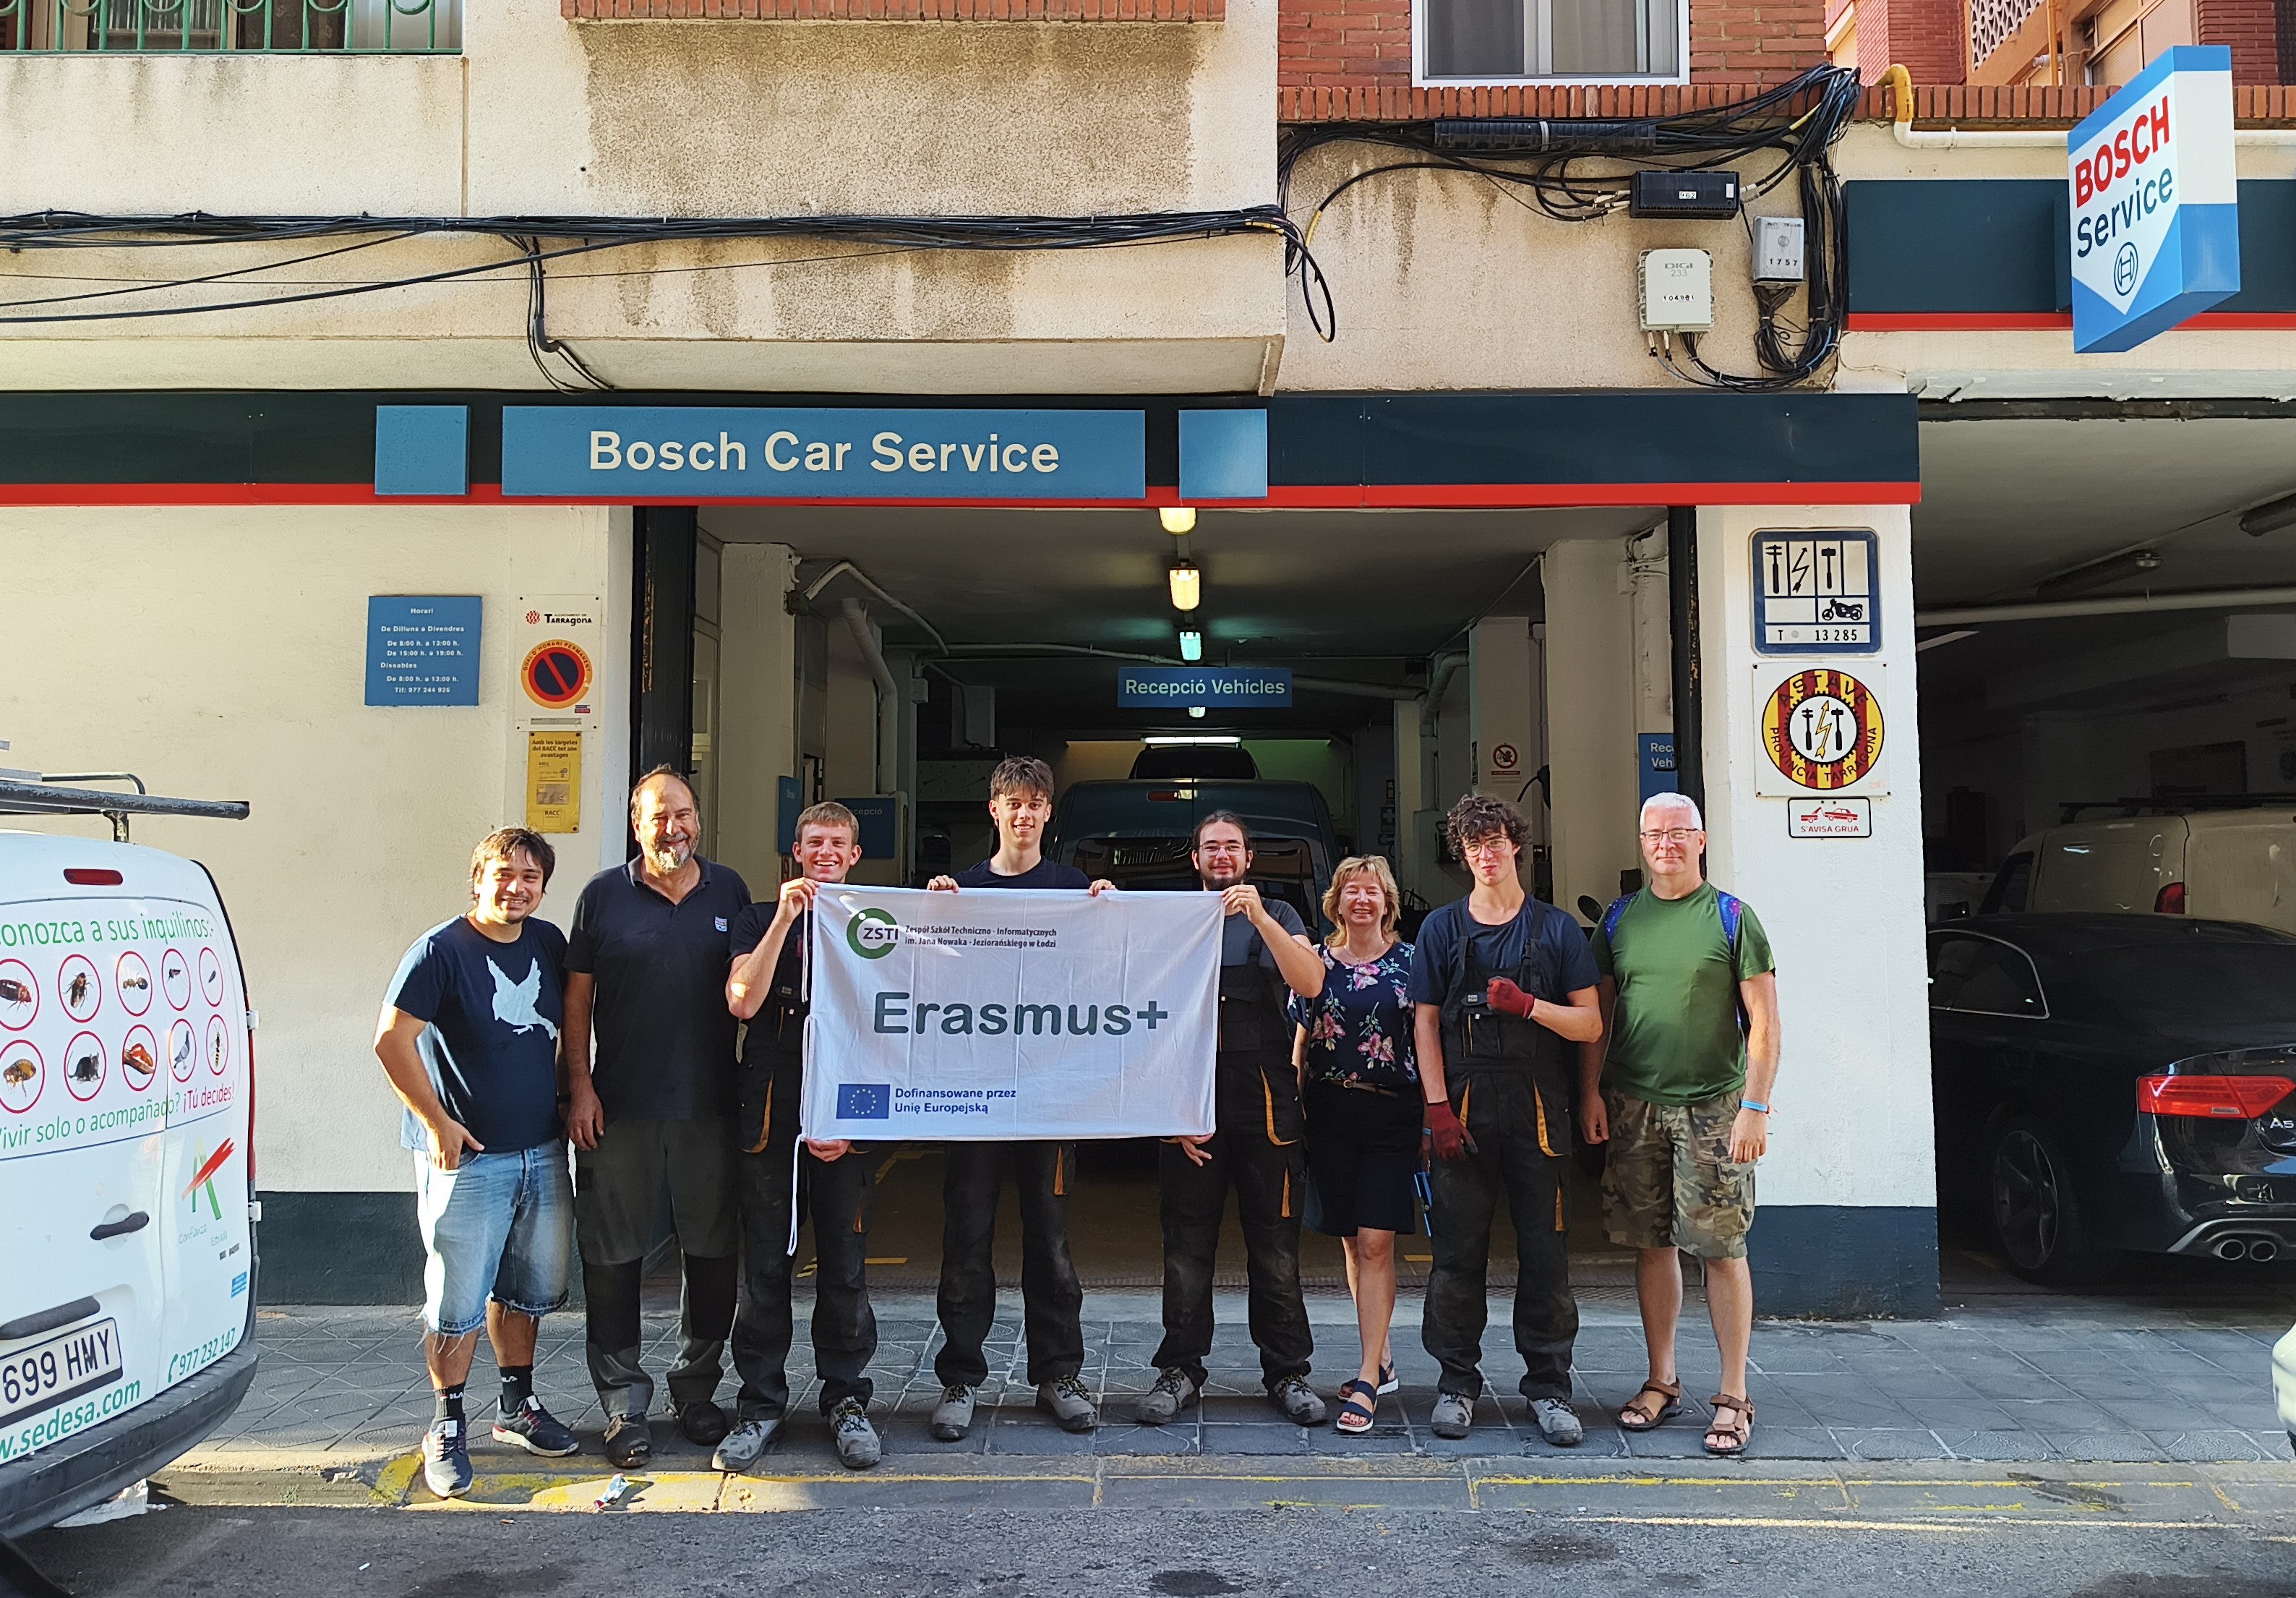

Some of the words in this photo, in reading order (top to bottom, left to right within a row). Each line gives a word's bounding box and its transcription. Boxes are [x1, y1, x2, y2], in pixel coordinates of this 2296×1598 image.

[2075, 95, 2169, 209] BOSCH
[2077, 167, 2173, 259] Service
[590, 430, 746, 471] Bosch
[764, 431, 852, 471] Car
[870, 432, 1060, 473] Service
[1778, 629, 1784, 641] T
[1126, 678, 1206, 697] Recepció
[1211, 678, 1285, 695] Vehícles
[1650, 743, 1674, 753] Rec
[1770, 727, 1816, 780] PROVINCIA
[1824, 727, 1877, 782] TARRAGONA
[0, 920, 85, 947] onozca
[91, 920, 103, 942] a
[108, 919, 139, 941] sus
[862, 927, 899, 940] ZSTI
[904, 925, 930, 935] Zespół
[930, 925, 951, 934] Szkół
[951, 926, 991, 935] Techniczno
[997, 927, 1057, 937] Informatycznych
[904, 936, 917, 945] im.
[918, 936, 936, 946] Jana
[938, 937, 967, 946] Nowaka
[972, 937, 1028, 949] Jeziorańskiego
[1036, 939, 1056, 948] Łodzi
[873, 991, 1168, 1035] Erasmus+
[895, 1088, 983, 1098] Dofinansowane
[986, 1089, 1017, 1100] przez
[0, 1124, 31, 1149] ivir
[36, 1116, 71, 1142] solo
[76, 1117, 85, 1134] o
[90, 1092, 181, 1132] acompañado?
[184, 1088, 198, 1114] ¡Tú
[200, 1082, 235, 1106] decides!
[894, 1103, 921, 1114] Unię
[924, 1103, 988, 1114] Europejską
[2270, 1117, 2295, 1129] A5
[179, 1350, 198, 1376] 977
[200, 1338, 218, 1364] 232
[220, 1328, 236, 1354] 147
[3, 1351, 57, 1404] 699
[64, 1328, 110, 1380] HMY
